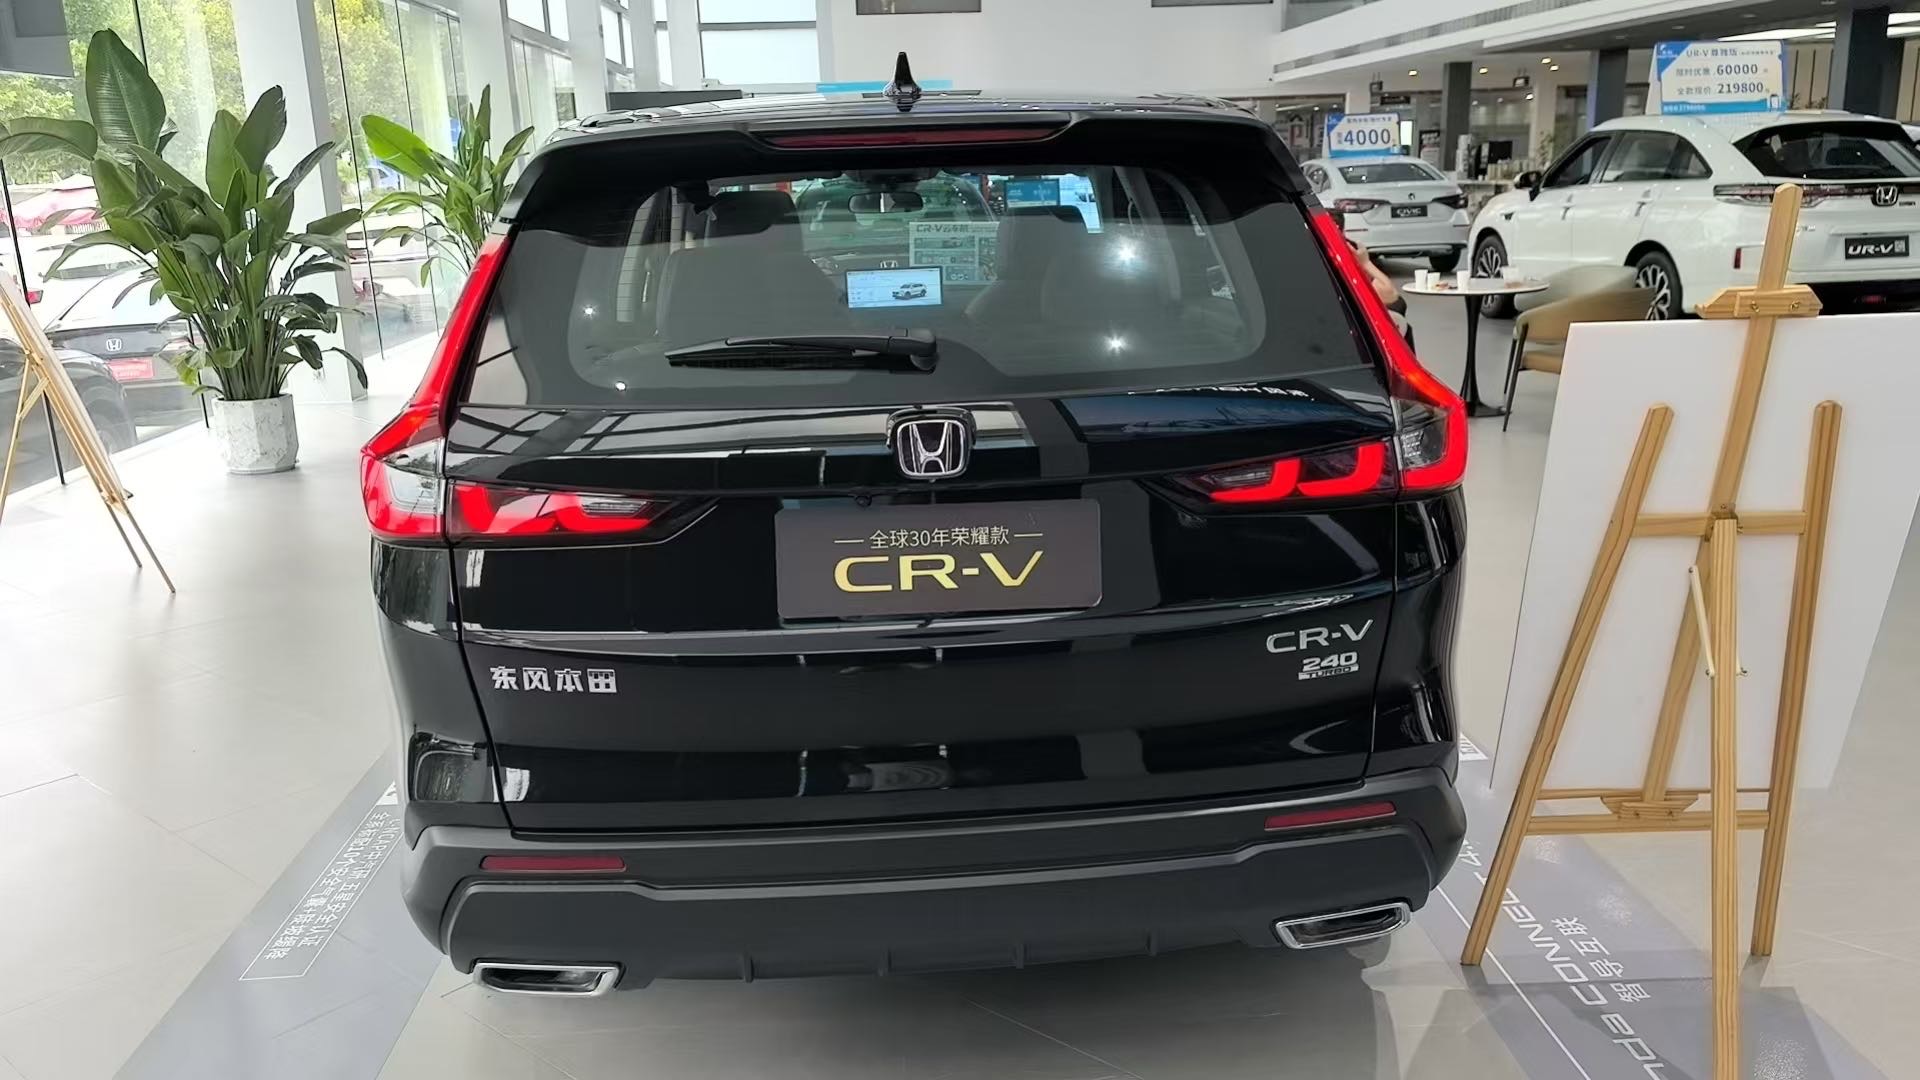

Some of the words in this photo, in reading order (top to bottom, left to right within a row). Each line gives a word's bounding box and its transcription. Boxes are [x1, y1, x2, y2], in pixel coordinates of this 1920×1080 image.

[1686, 48, 1709, 57] UR-V
[1716, 63, 1758, 76] 60000
[1717, 82, 1764, 94] 219800
[1344, 128, 1391, 145] 4000
[1848, 243, 1894, 255] UR-V
[869, 526, 1010, 549] 全球30年荣耀款
[834, 550, 1044, 592] CR-V
[1266, 619, 1374, 653] CR-V
[1302, 651, 1358, 672] 240
[1308, 664, 1354, 679] TURBO
[490, 666, 618, 693] 东风本田
[297, 882, 361, 948] 五星安全认证
[1551, 915, 1652, 1004] 智导互联
